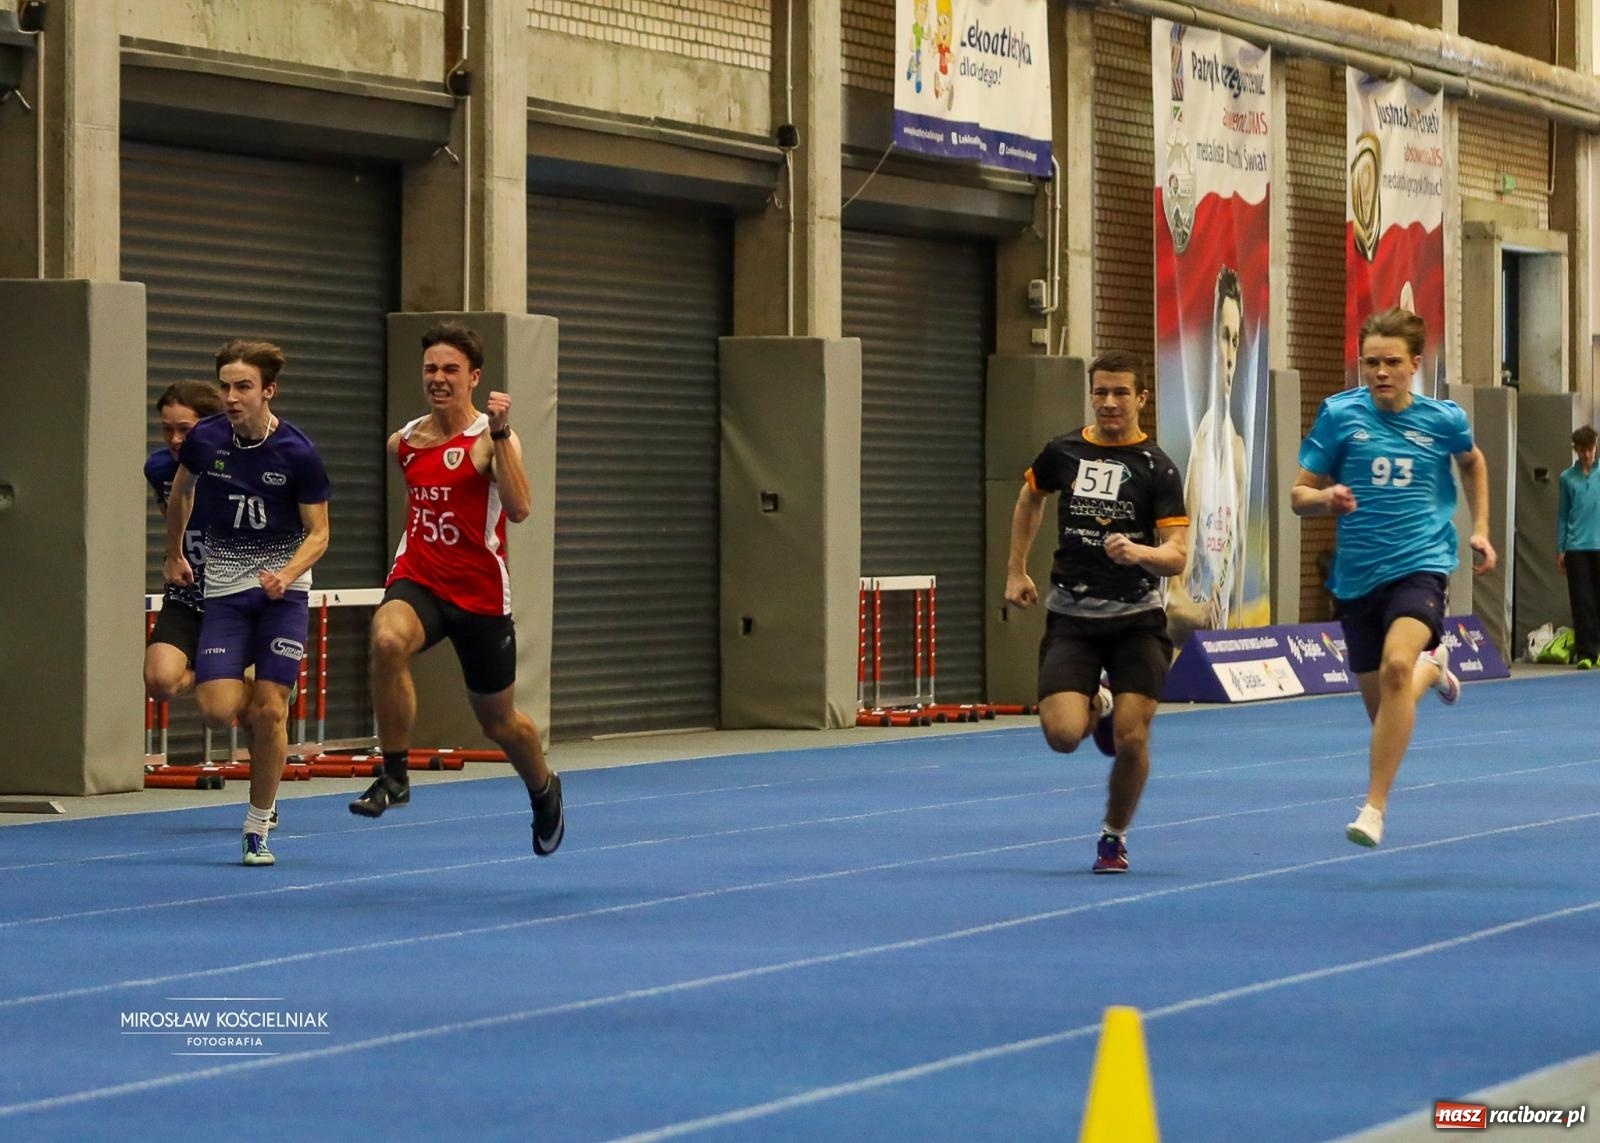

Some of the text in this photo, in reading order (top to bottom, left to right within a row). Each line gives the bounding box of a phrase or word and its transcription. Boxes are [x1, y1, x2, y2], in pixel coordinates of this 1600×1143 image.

[959, 56, 977, 78] dla
[1081, 467, 1114, 495] 51
[1371, 456, 1413, 487] 93
[228, 494, 267, 530] 70
[410, 506, 460, 546] 756
